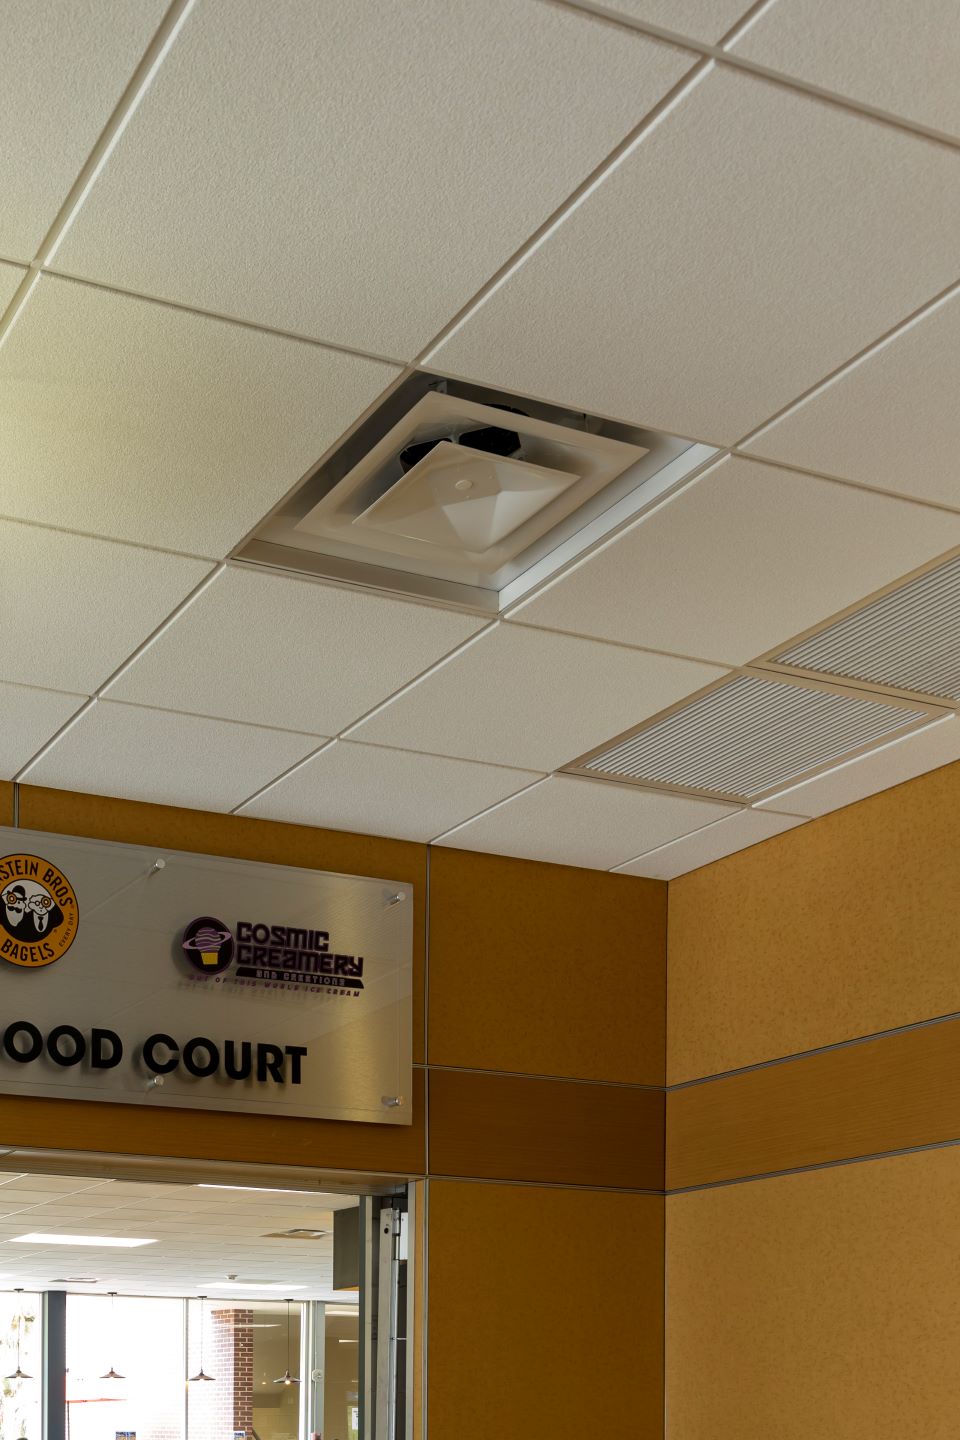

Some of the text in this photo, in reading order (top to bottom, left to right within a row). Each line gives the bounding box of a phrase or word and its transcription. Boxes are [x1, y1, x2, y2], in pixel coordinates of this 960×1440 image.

[42, 868, 73, 907] BROS
[0, 938, 55, 962] BAGELS
[236, 921, 330, 952] COSMIC
[142, 1033, 307, 1084] COURT
